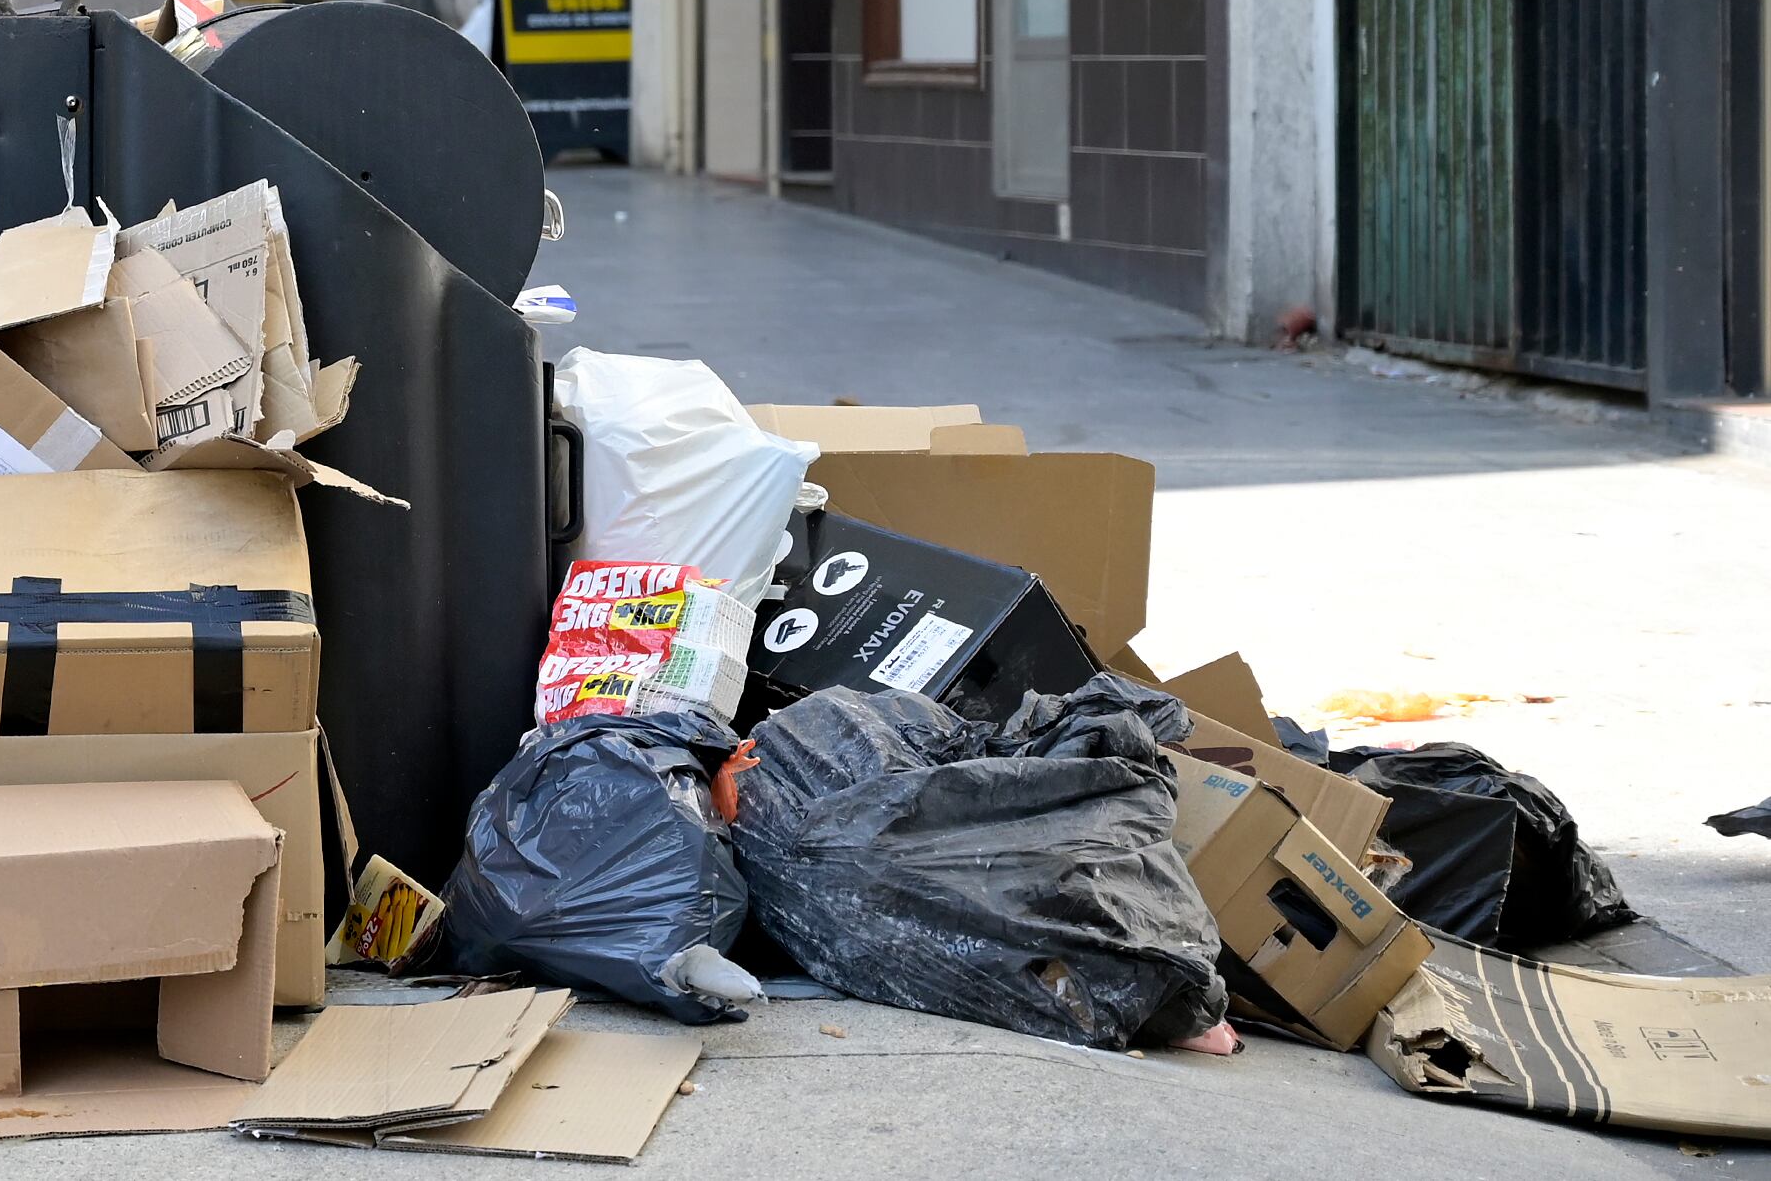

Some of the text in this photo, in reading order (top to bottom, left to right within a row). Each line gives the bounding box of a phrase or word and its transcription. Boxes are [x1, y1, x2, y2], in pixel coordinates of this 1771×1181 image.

[158, 218, 232, 252] COMPUTER CODE:
[227, 255, 258, 274] 750 mL
[564, 564, 683, 599] OFERTA
[554, 597, 612, 632] 3KG
[852, 589, 926, 663] EVOMAX
[538, 652, 663, 686] OFERTA
[1203, 774, 1249, 798] Baxter
[1302, 851, 1372, 919] Baxter
[356, 916, 379, 955] -24%
